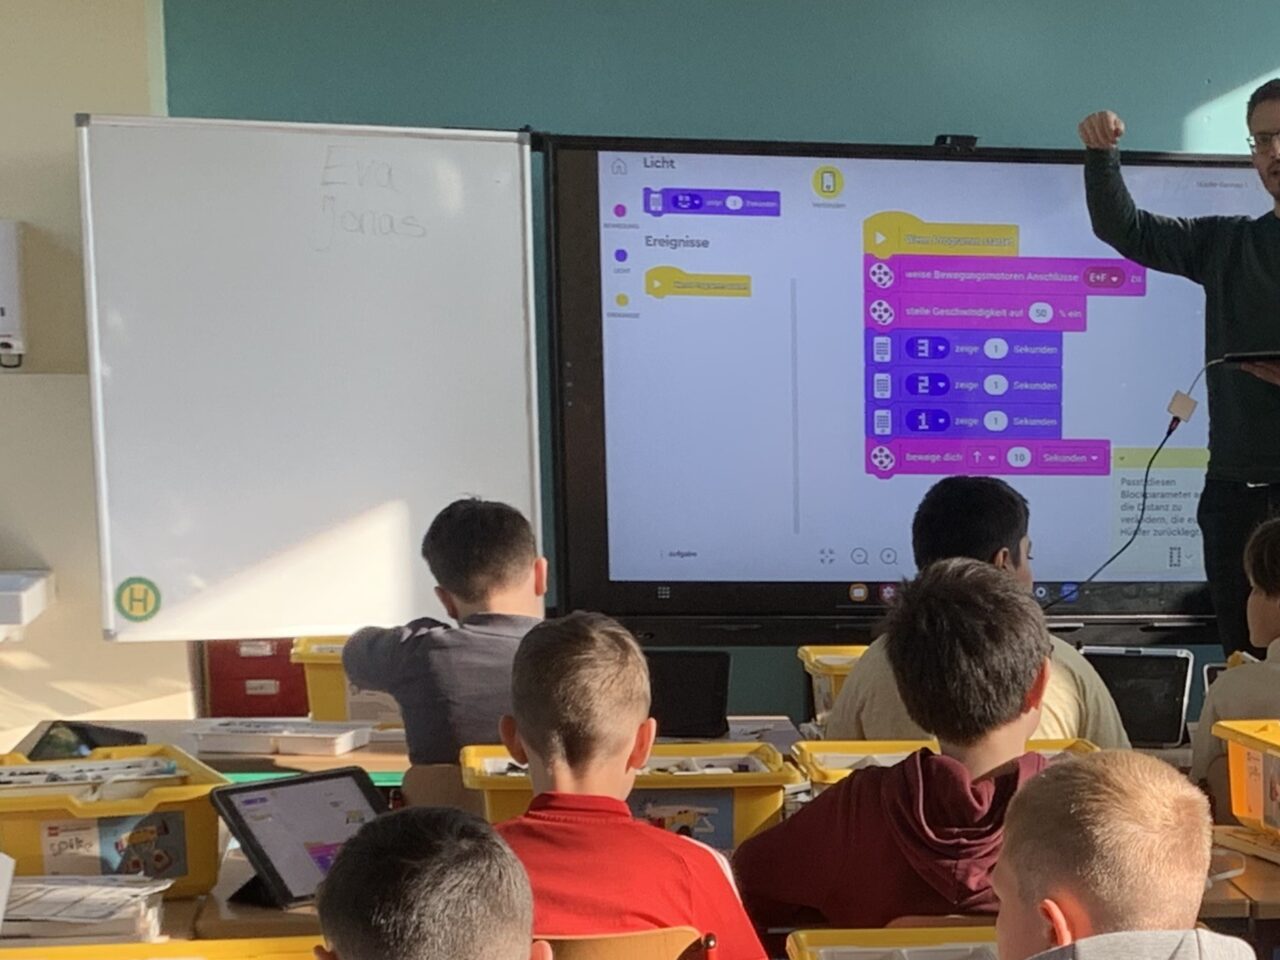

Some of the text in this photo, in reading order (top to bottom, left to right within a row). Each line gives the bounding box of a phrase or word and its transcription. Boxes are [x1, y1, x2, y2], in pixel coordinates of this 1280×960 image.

[643, 156, 676, 169] Licht
[645, 235, 710, 250] Ereignisse
[933, 270, 1025, 283] Bewegungsmotoren
[932, 306, 1007, 319] Geschwindigkeit
[1036, 309, 1048, 318] 50
[1013, 345, 1058, 354] Sekunden
[918, 376, 929, 393] 2
[1013, 381, 1058, 390] Sekunden
[1013, 417, 1057, 427] Sekunden
[1014, 453, 1026, 462] 10
[1043, 453, 1087, 463] Sekunden
[1137, 503, 1169, 512] Dstanz
